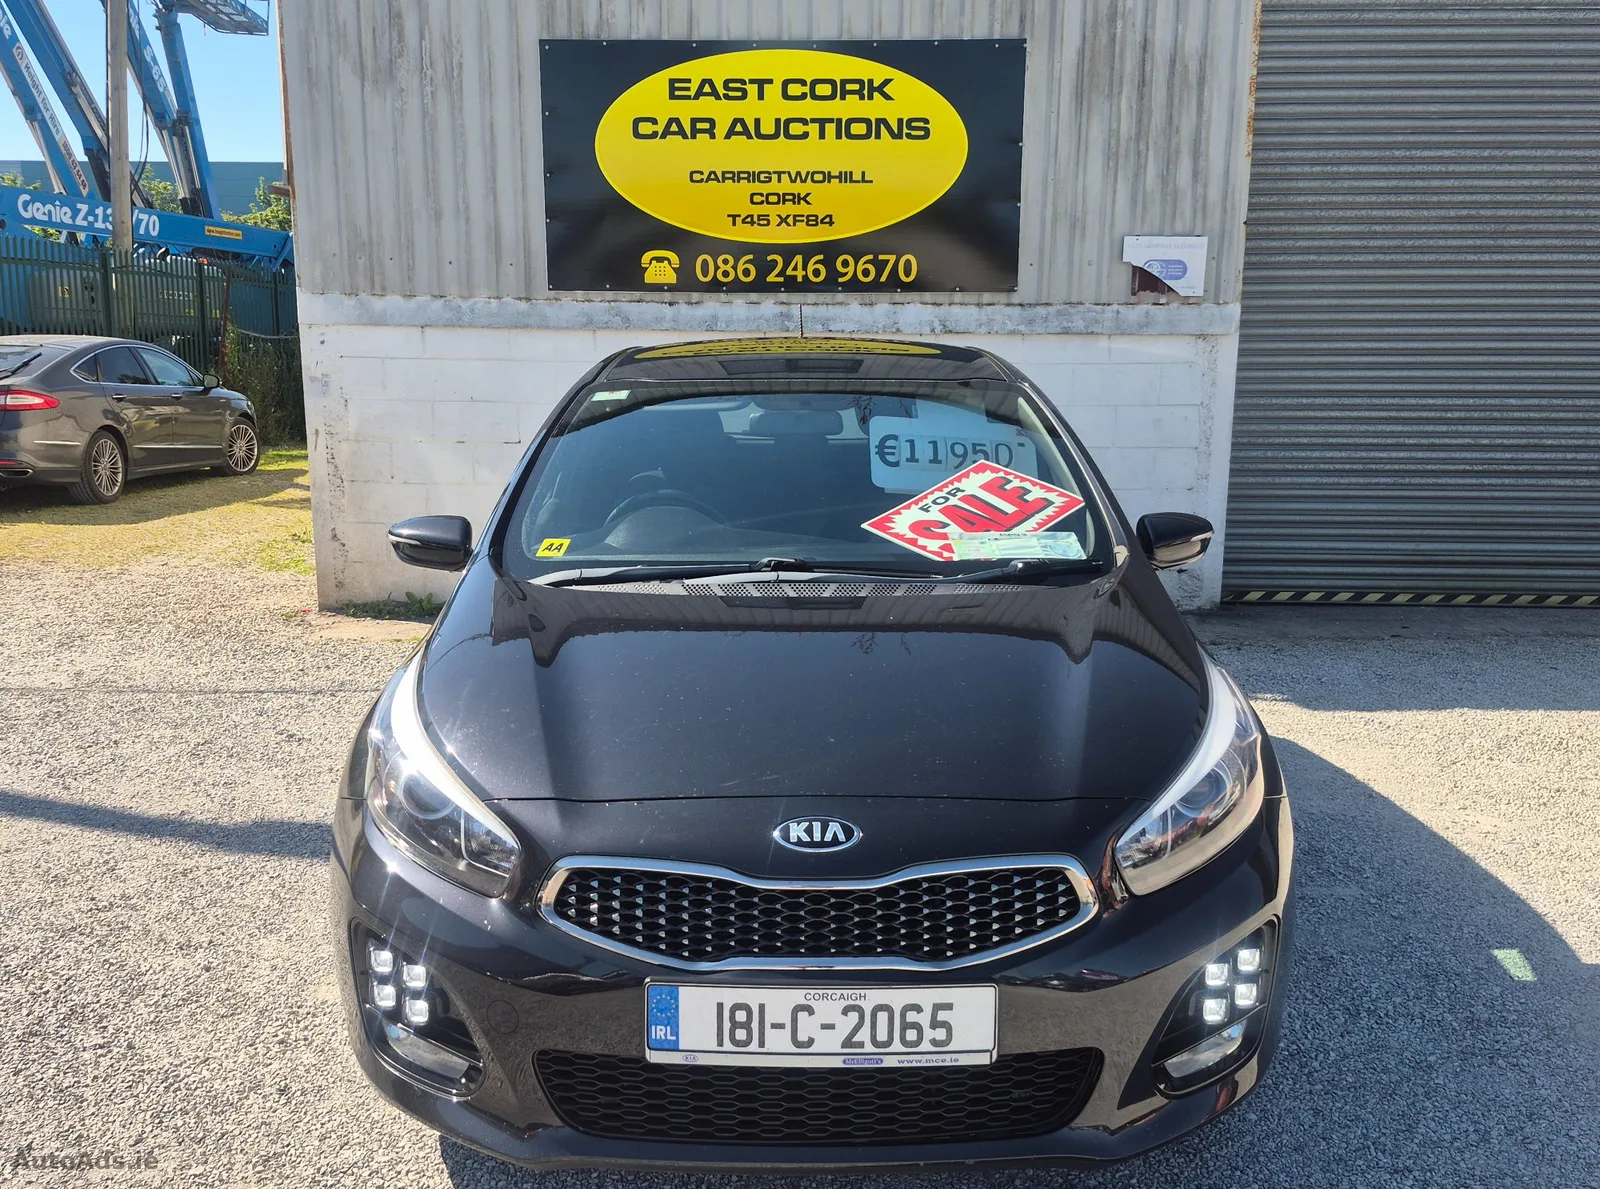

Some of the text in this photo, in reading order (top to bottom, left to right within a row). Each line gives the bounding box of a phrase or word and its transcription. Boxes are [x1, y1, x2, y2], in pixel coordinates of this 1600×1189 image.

[24, 62, 60, 135] Height for Hire
[667, 78, 895, 102] EAST CORK
[632, 117, 931, 141] CAR AUCTIONS
[689, 169, 873, 184] CARRIGTWOHILL
[17, 193, 74, 225] Genie
[749, 192, 813, 206] CORK
[727, 213, 835, 228] T45 XF84
[695, 253, 918, 283] 086 246 9670
[918, 486, 967, 514] FOR
[908, 476, 1056, 555] SALE
[541, 542, 564, 553] AA
[788, 821, 847, 843] KIA
[804, 992, 867, 1002] CORCAIGH
[651, 1025, 677, 1041] IRL
[716, 1002, 954, 1050] 181-C-2065
[897, 1057, 960, 1065] www.mce.ie
